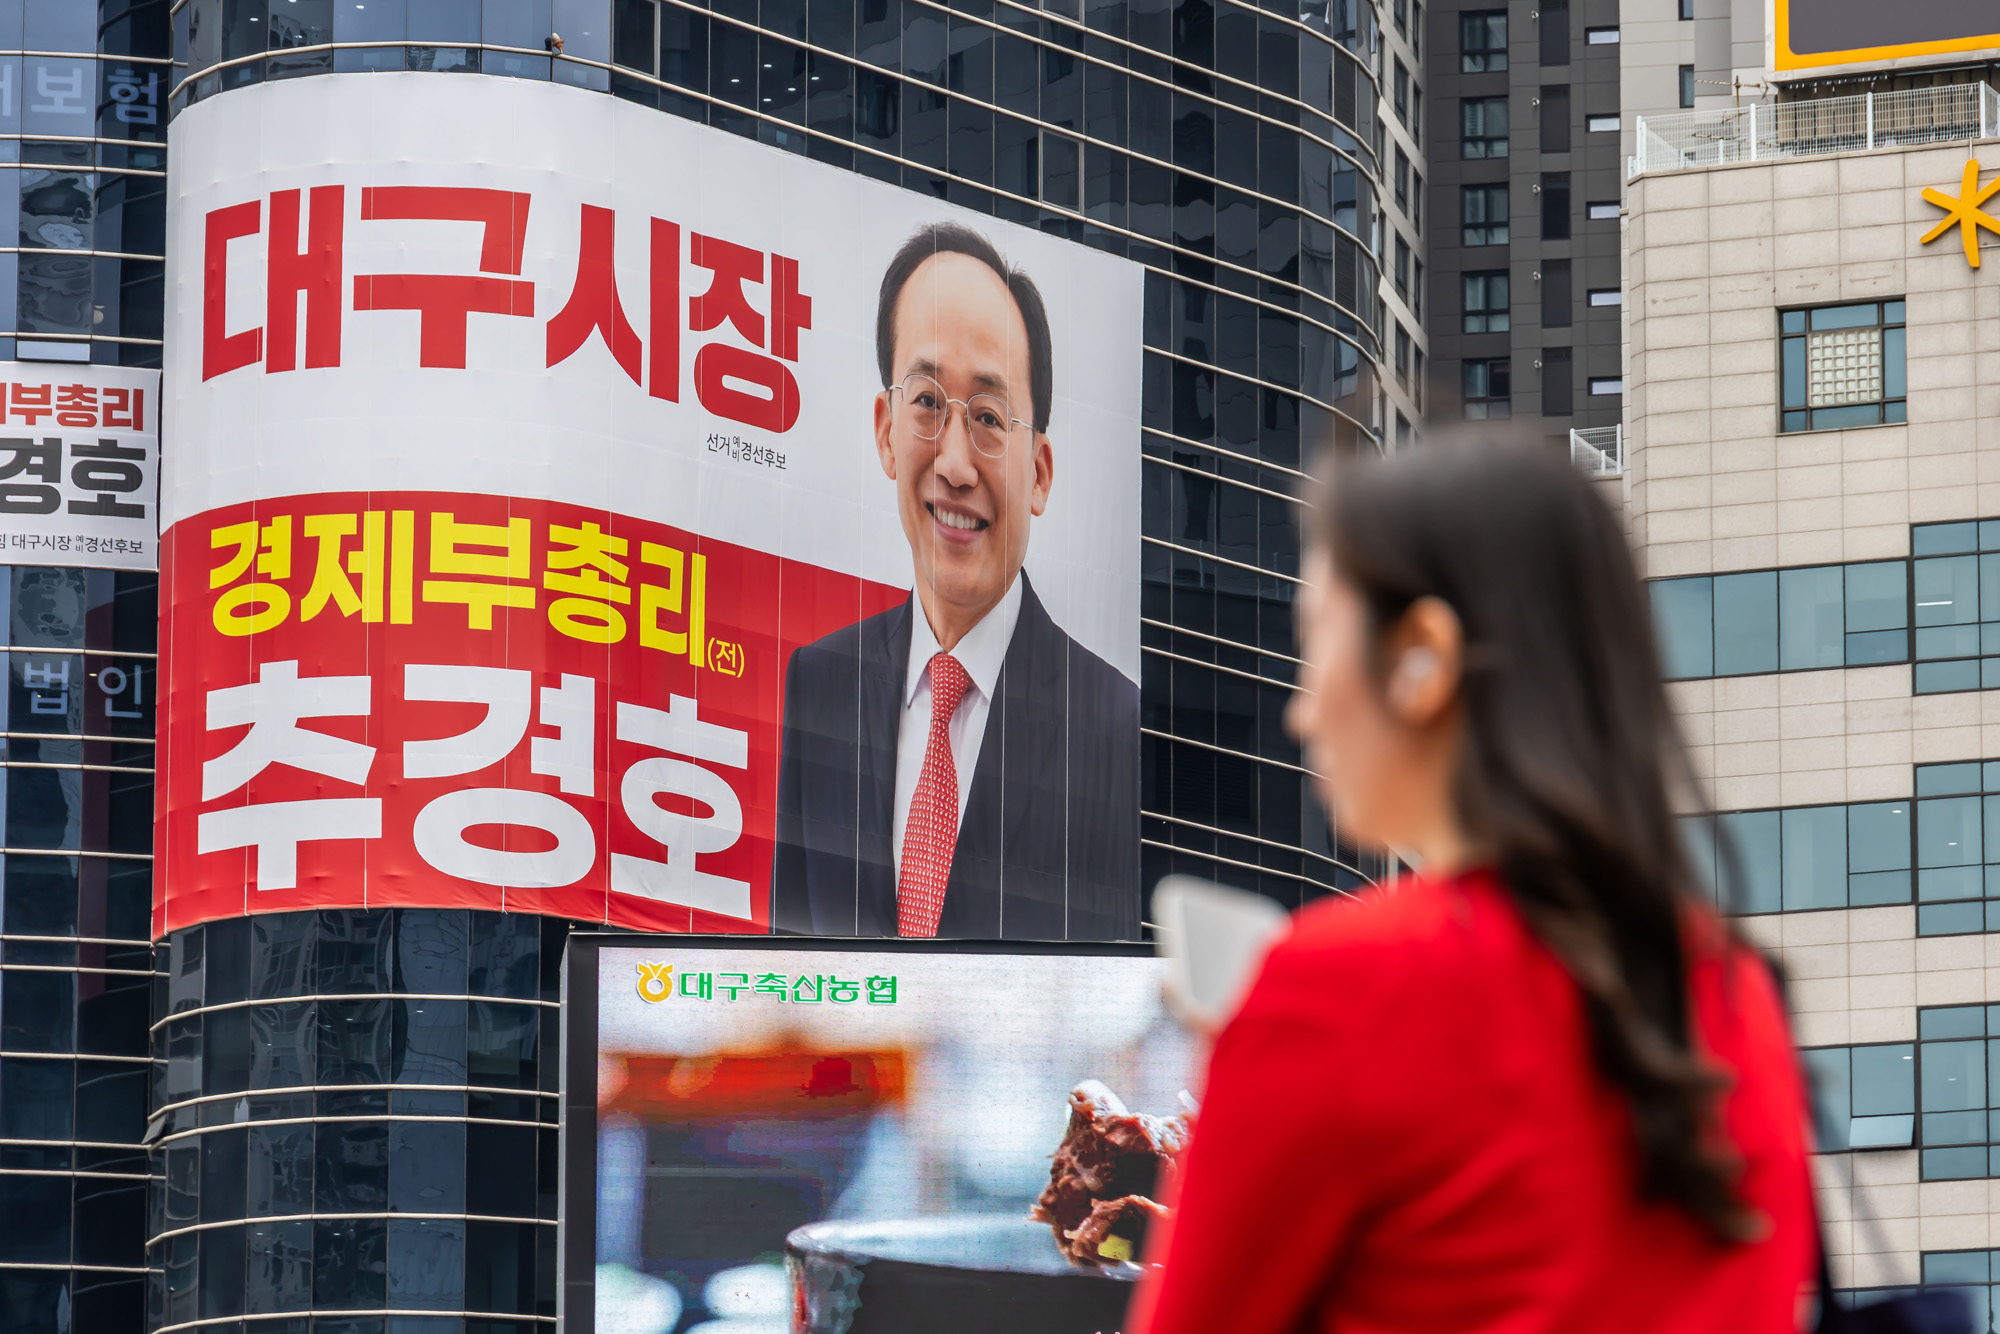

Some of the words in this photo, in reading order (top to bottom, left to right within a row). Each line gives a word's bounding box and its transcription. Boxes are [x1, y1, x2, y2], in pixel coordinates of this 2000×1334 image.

[202, 184, 812, 434] 대구시장
[0, 382, 144, 431] 부총리
[0, 437, 146, 519] 경호
[12, 534, 71, 551] 대구시장
[24, 660, 143, 719] 법인
[198, 659, 753, 921] 추경호
[679, 971, 898, 1005] 대구축산농협
